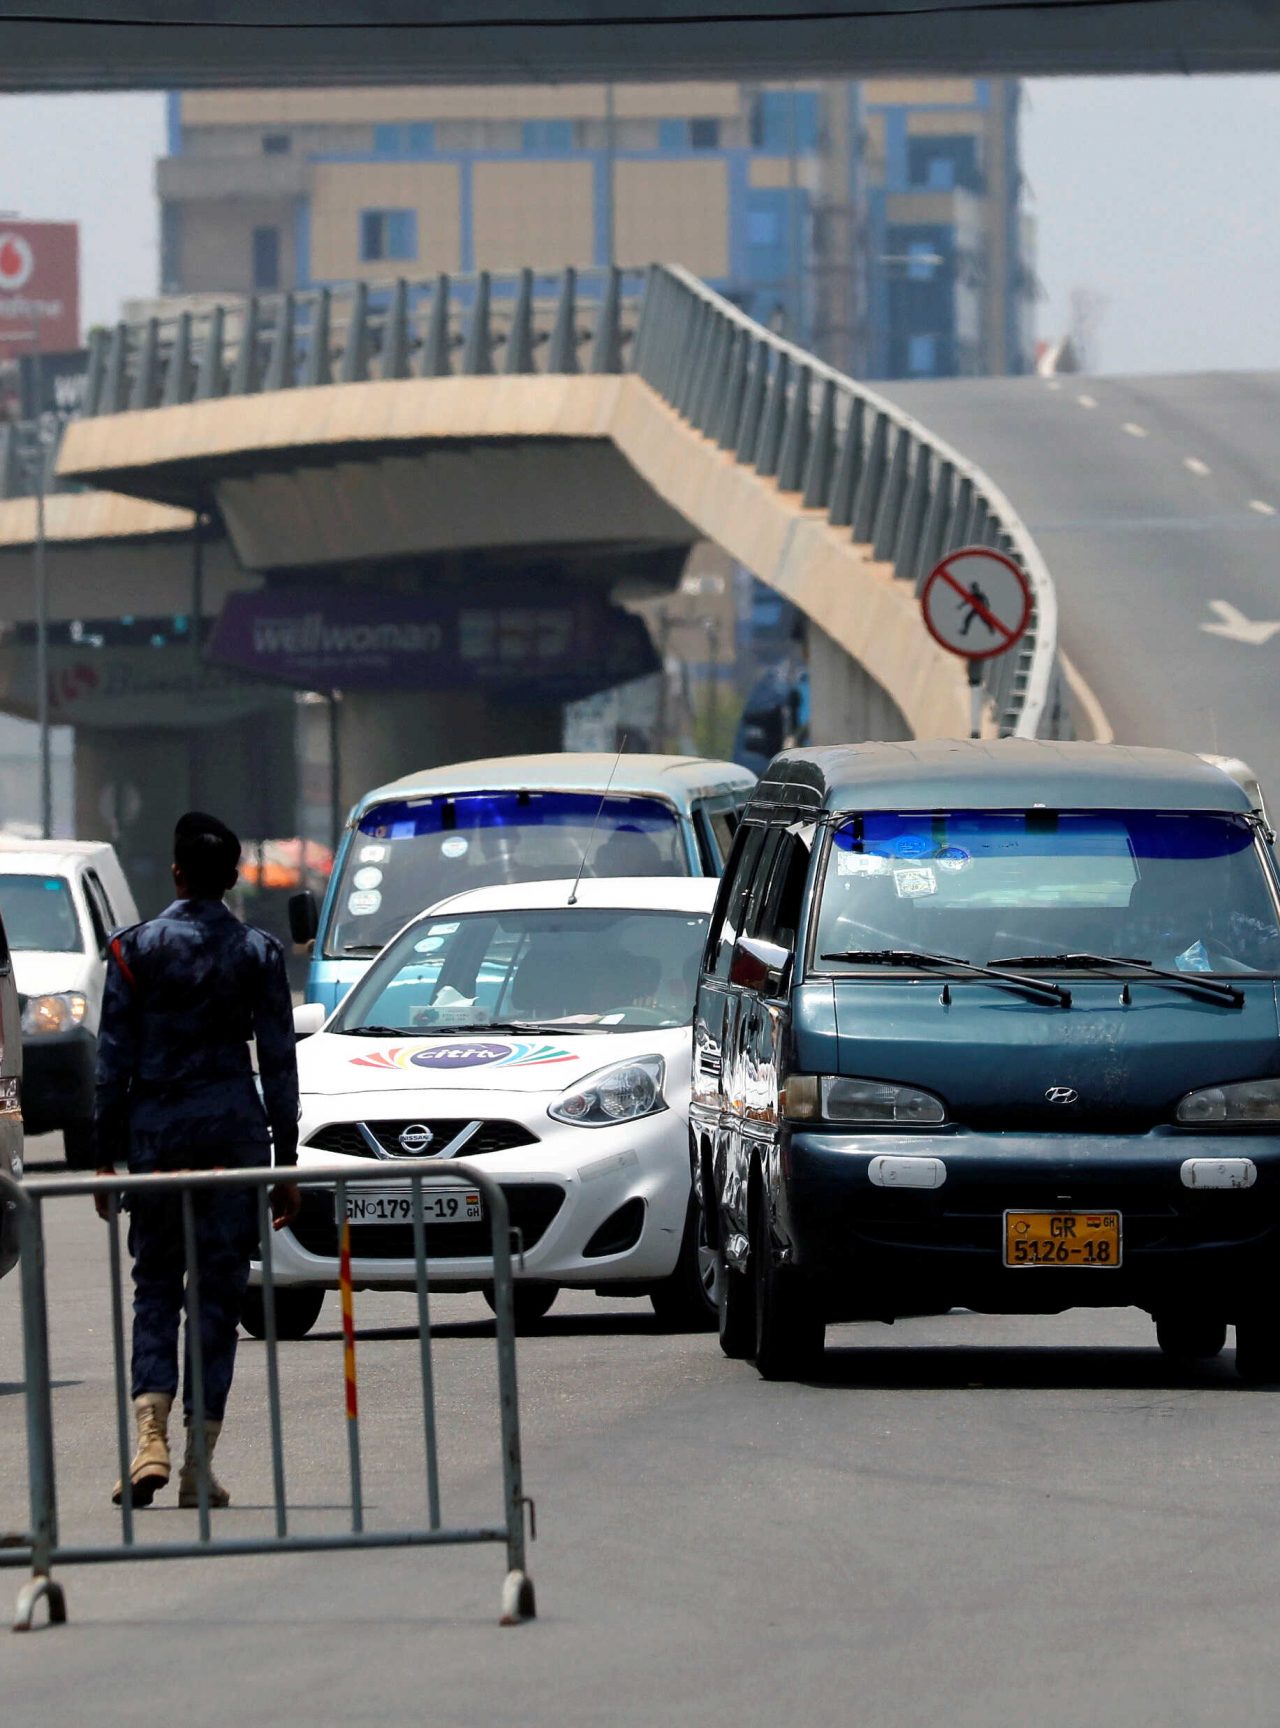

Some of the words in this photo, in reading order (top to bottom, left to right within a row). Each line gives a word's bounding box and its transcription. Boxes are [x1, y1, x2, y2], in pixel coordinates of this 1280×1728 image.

[253, 612, 442, 653] wellwoman
[401, 1134, 429, 1142] NISSAN
[376, 1198, 459, 1219] 179-19
[466, 1206, 480, 1217] GH
[1050, 1216, 1077, 1239] GR
[1103, 1217, 1115, 1228] GH
[1014, 1240, 1110, 1263] 5126-18
